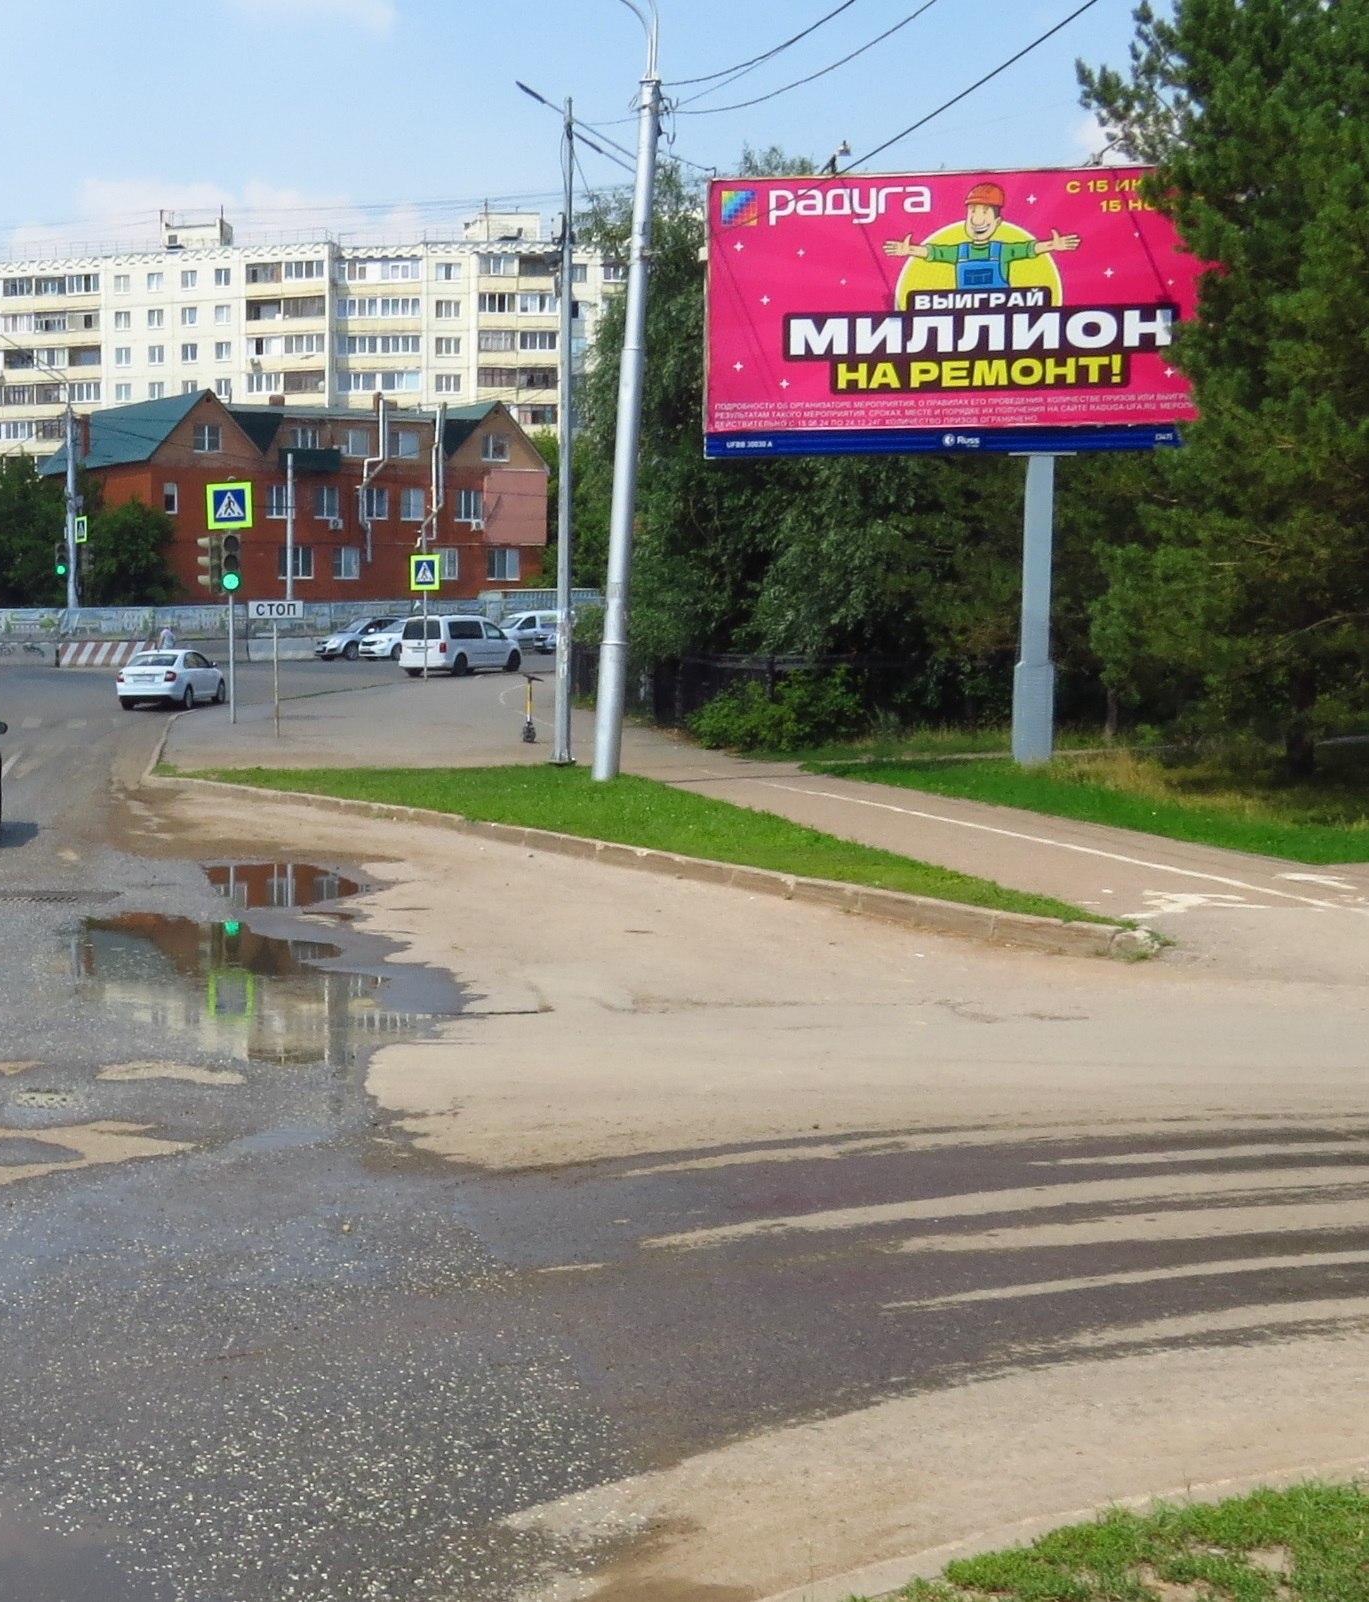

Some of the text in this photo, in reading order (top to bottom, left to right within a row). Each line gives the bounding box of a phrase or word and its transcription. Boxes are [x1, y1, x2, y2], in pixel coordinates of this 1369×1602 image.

[1066, 180, 1081, 194] С
[1087, 180, 1108, 193] 15
[769, 186, 931, 226] радуга
[1100, 200, 1121, 213] 15
[914, 288, 1044, 310] ВЫИГРАЙ
[789, 309, 1173, 355] МИЛЛИОН
[837, 355, 1122, 390] НА РЕМОНТ!
[256, 603, 296, 616] СТОП
